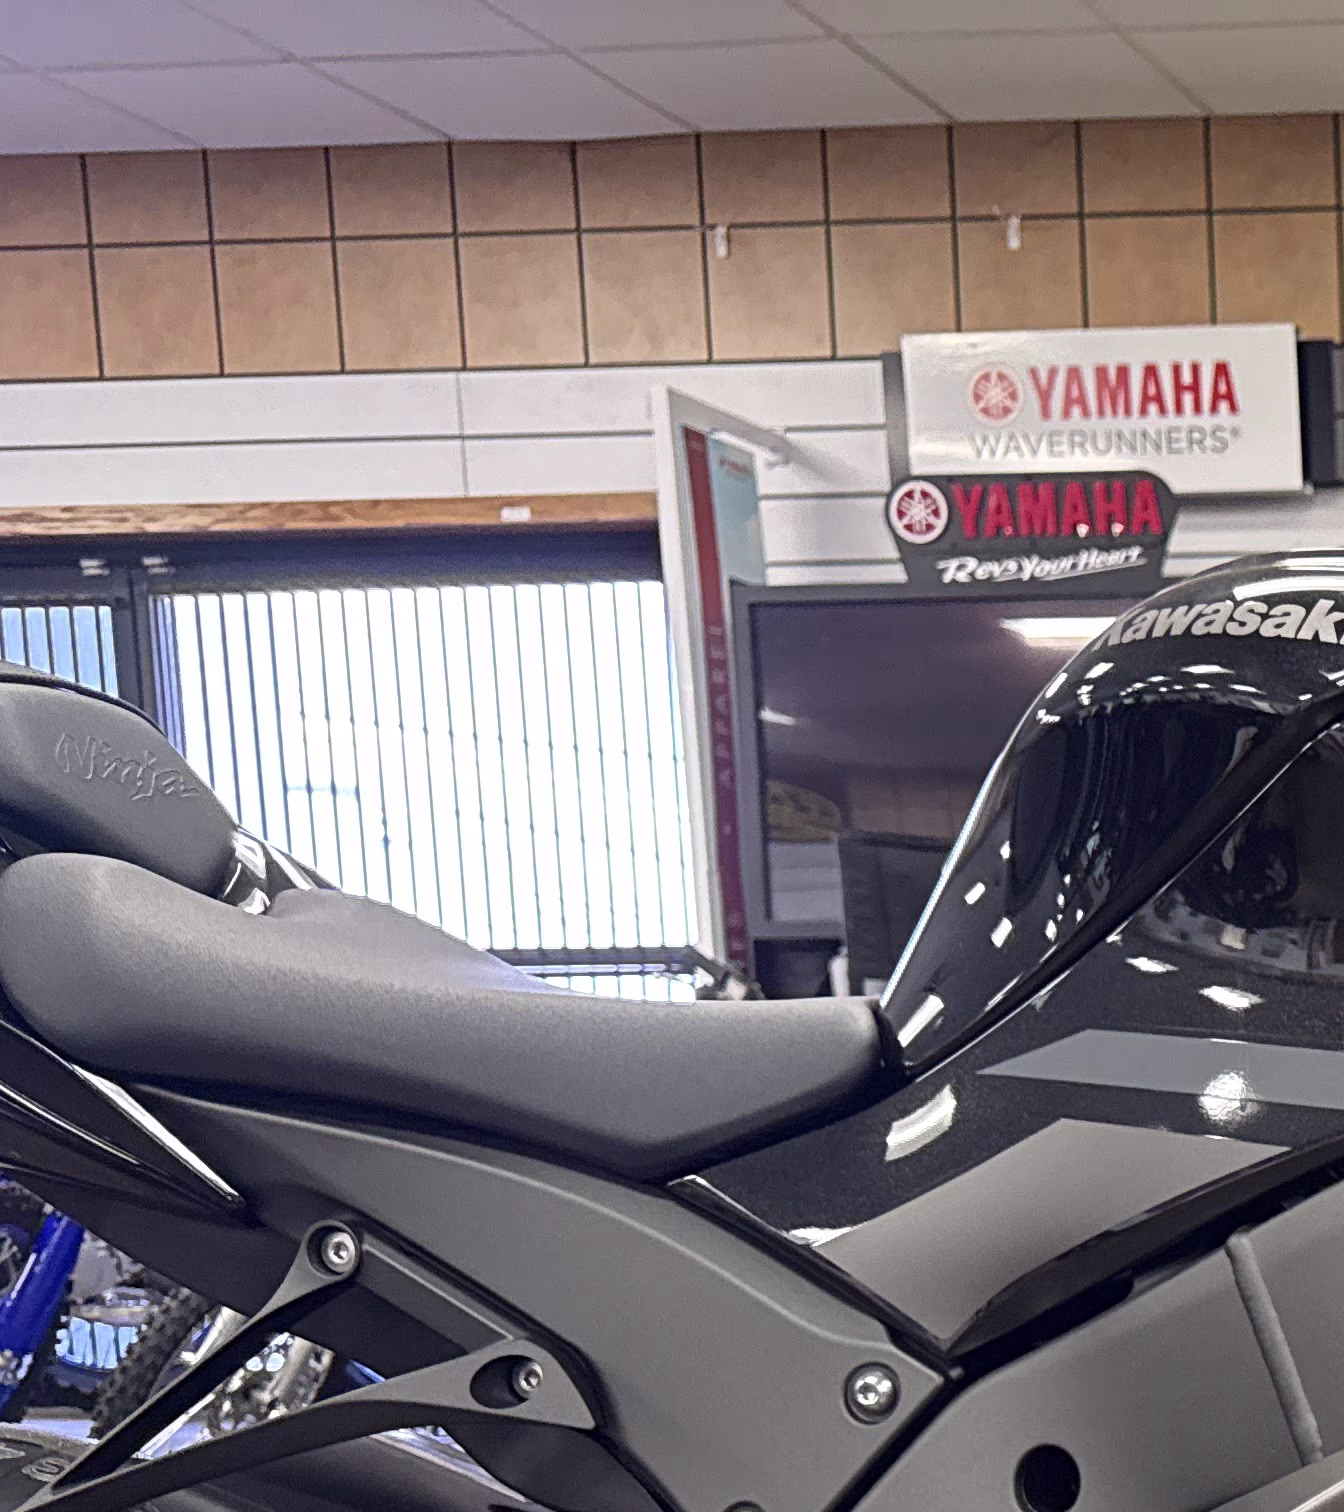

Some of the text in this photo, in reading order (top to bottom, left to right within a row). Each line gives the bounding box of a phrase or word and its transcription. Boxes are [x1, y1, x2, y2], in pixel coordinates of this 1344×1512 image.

[1028, 360, 1241, 421] YAMAHA
[951, 480, 1164, 539] YAMAHA
[1078, 545, 1144, 570] Heart
[54, 731, 202, 802] Ninja
